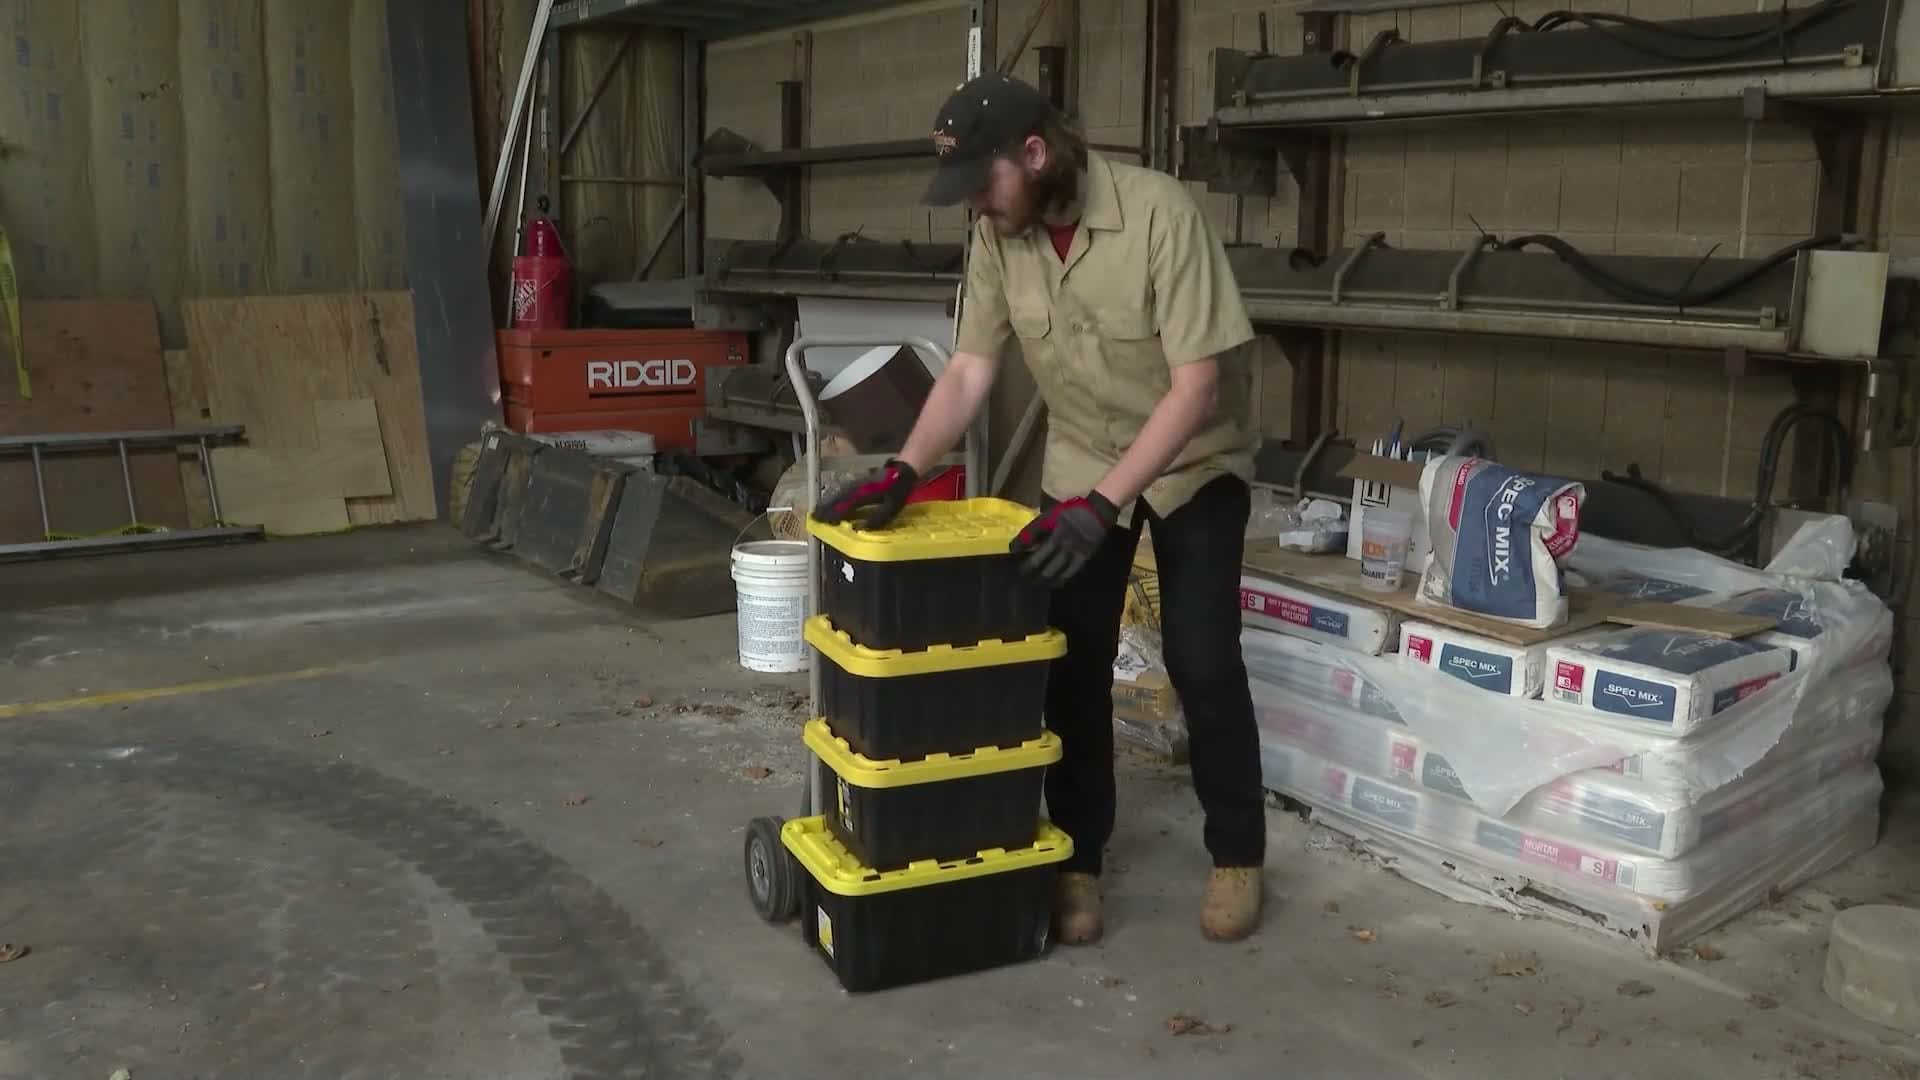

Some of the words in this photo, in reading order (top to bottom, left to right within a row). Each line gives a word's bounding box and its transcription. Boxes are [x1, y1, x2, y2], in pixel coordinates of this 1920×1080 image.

[587, 359, 697, 388] RIDGID
[1497, 475, 1535, 521] SPEC
[1494, 526, 1510, 574] MIX
[1249, 595, 1256, 607] S
[1281, 608, 1308, 624] MORTAR
[1453, 656, 1478, 668] SPEC
[1478, 662, 1497, 673] MIX
[1608, 684, 1637, 697] SPEC
[1638, 691, 1658, 702] MIX
[1524, 839, 1559, 856] MORTAR
[1593, 861, 1602, 875] S
